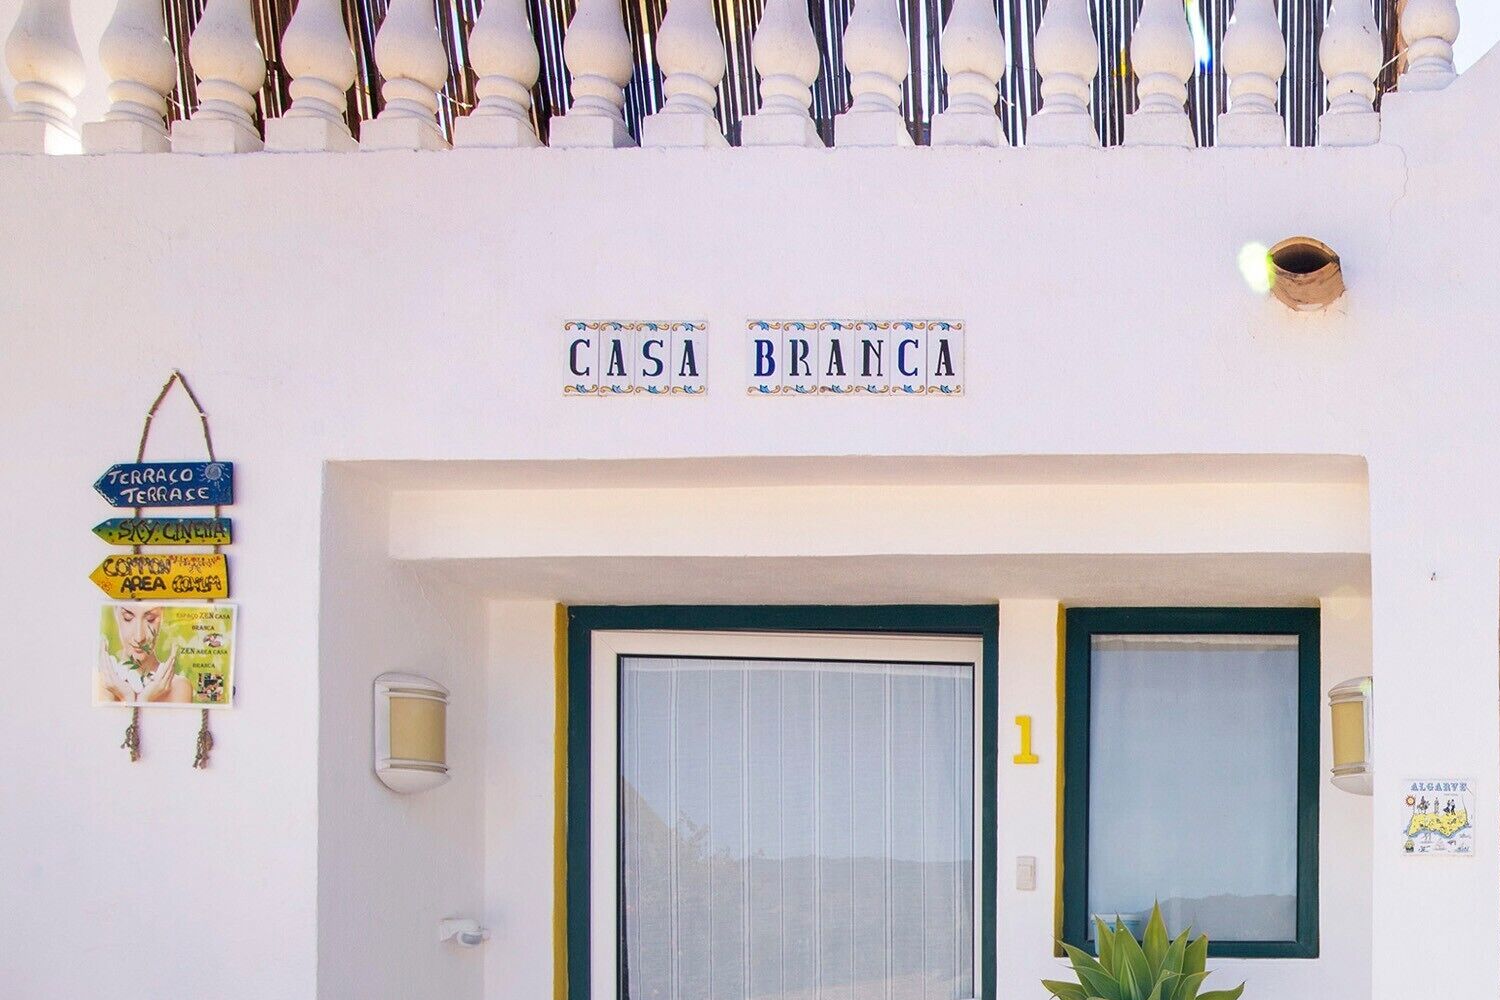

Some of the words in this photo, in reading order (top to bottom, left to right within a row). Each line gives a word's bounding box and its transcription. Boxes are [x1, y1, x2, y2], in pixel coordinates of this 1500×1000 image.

[568, 339, 700, 377] CASA
[753, 338, 956, 377] BRANCA
[107, 468, 194, 485] TERRAÇO
[117, 519, 160, 545] SKY
[162, 519, 226, 541] CINEMA
[102, 556, 171, 577] COMMON
[120, 576, 167, 594] AREA
[199, 610, 214, 620] ZEN
[180, 647, 195, 655] ZEN
[1013, 715, 1039, 765] 1
[1410, 782, 1468, 792] ALGARVE
